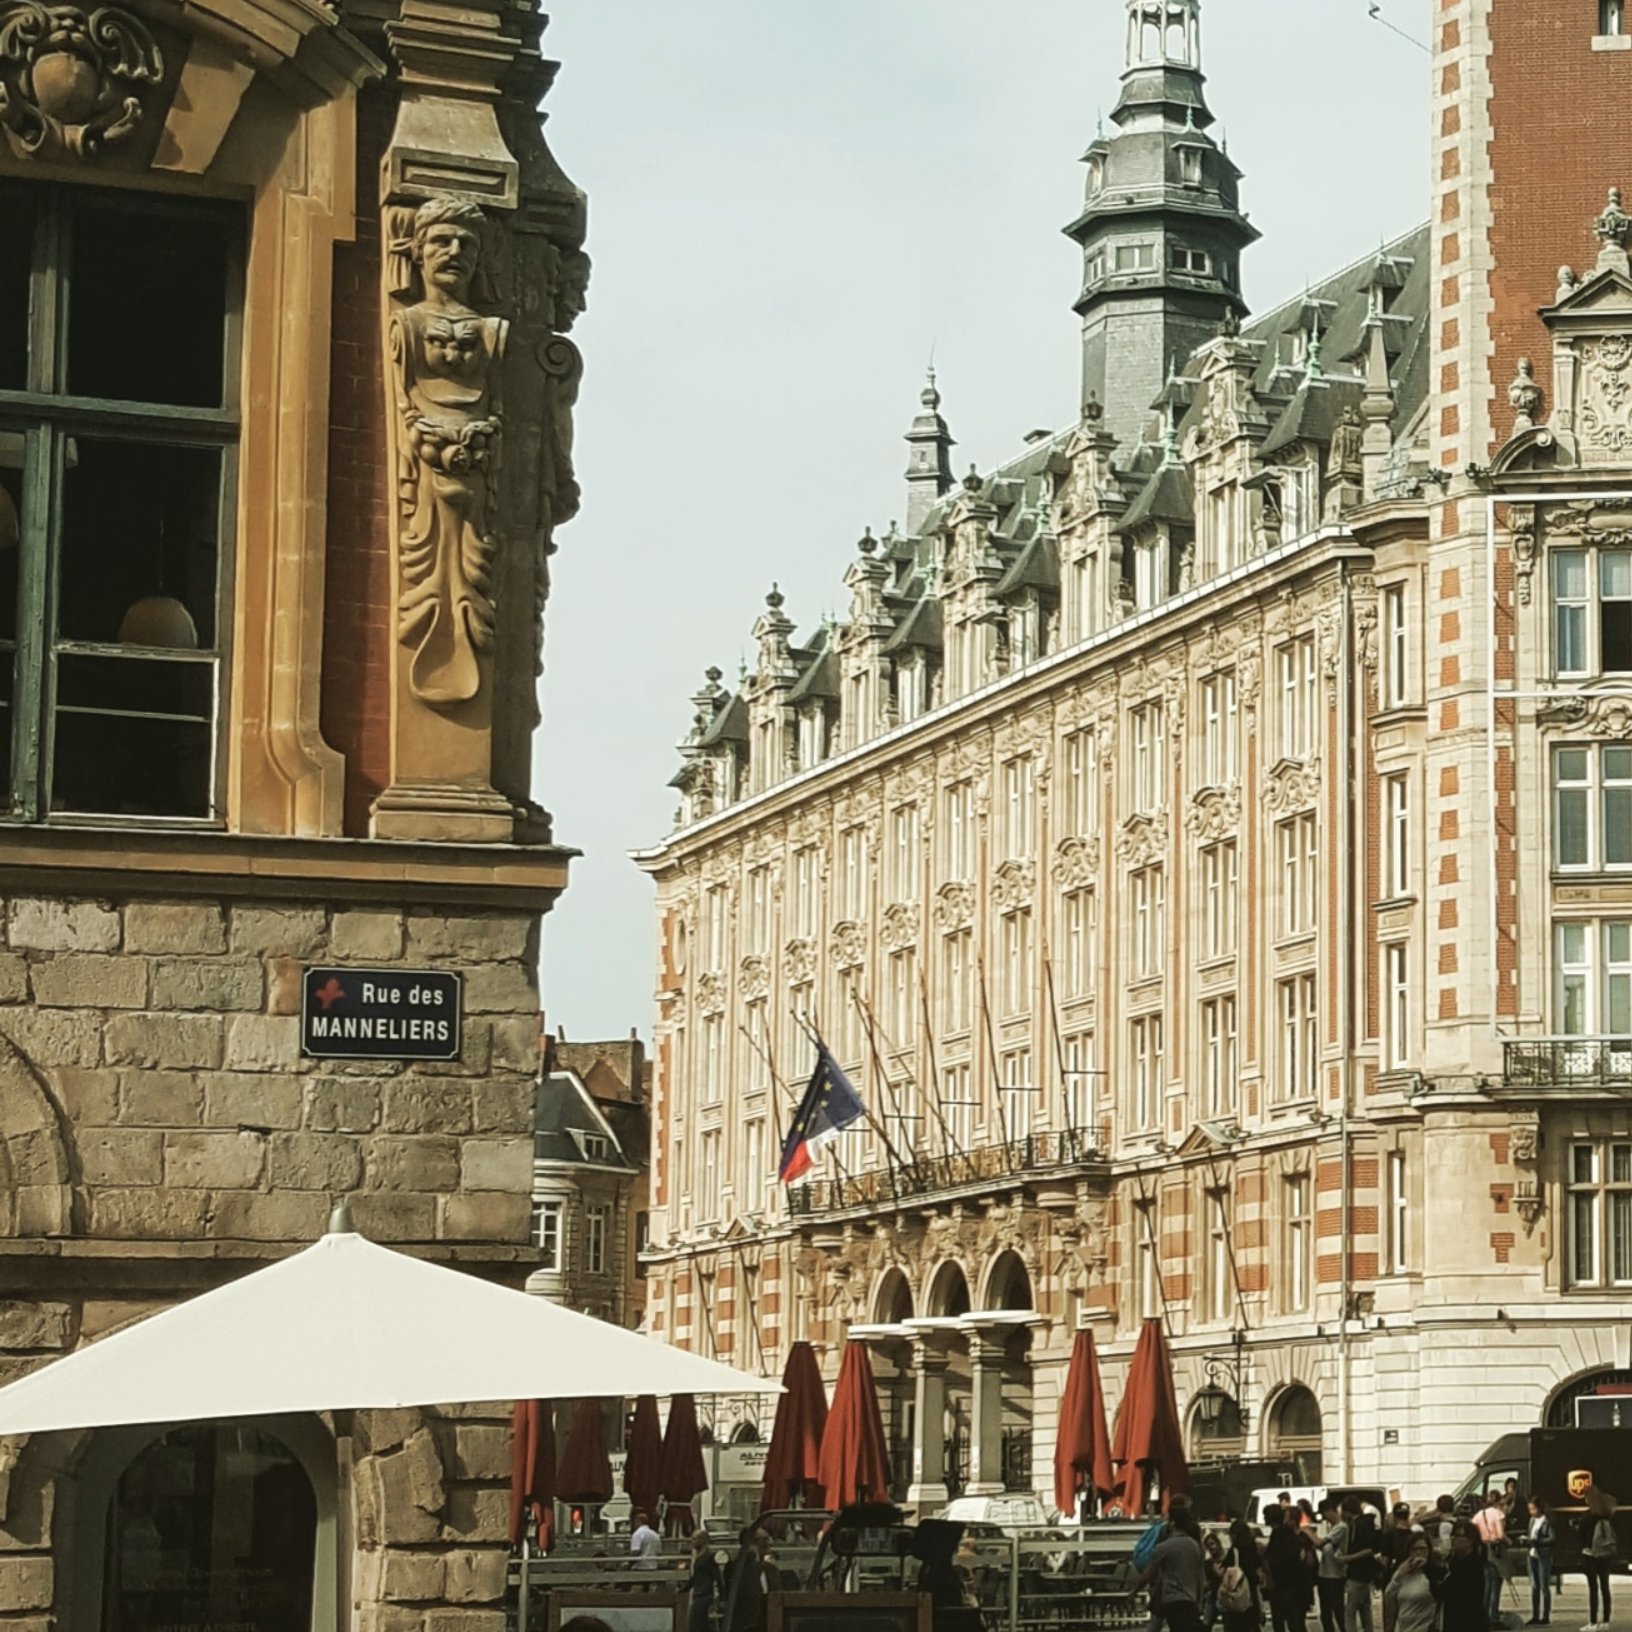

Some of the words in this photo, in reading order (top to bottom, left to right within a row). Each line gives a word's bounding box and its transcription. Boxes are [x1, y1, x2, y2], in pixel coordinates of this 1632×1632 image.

[362, 982, 401, 1004] Rue
[409, 984, 444, 1006] des
[312, 1016, 449, 1041] MANNELIERS
